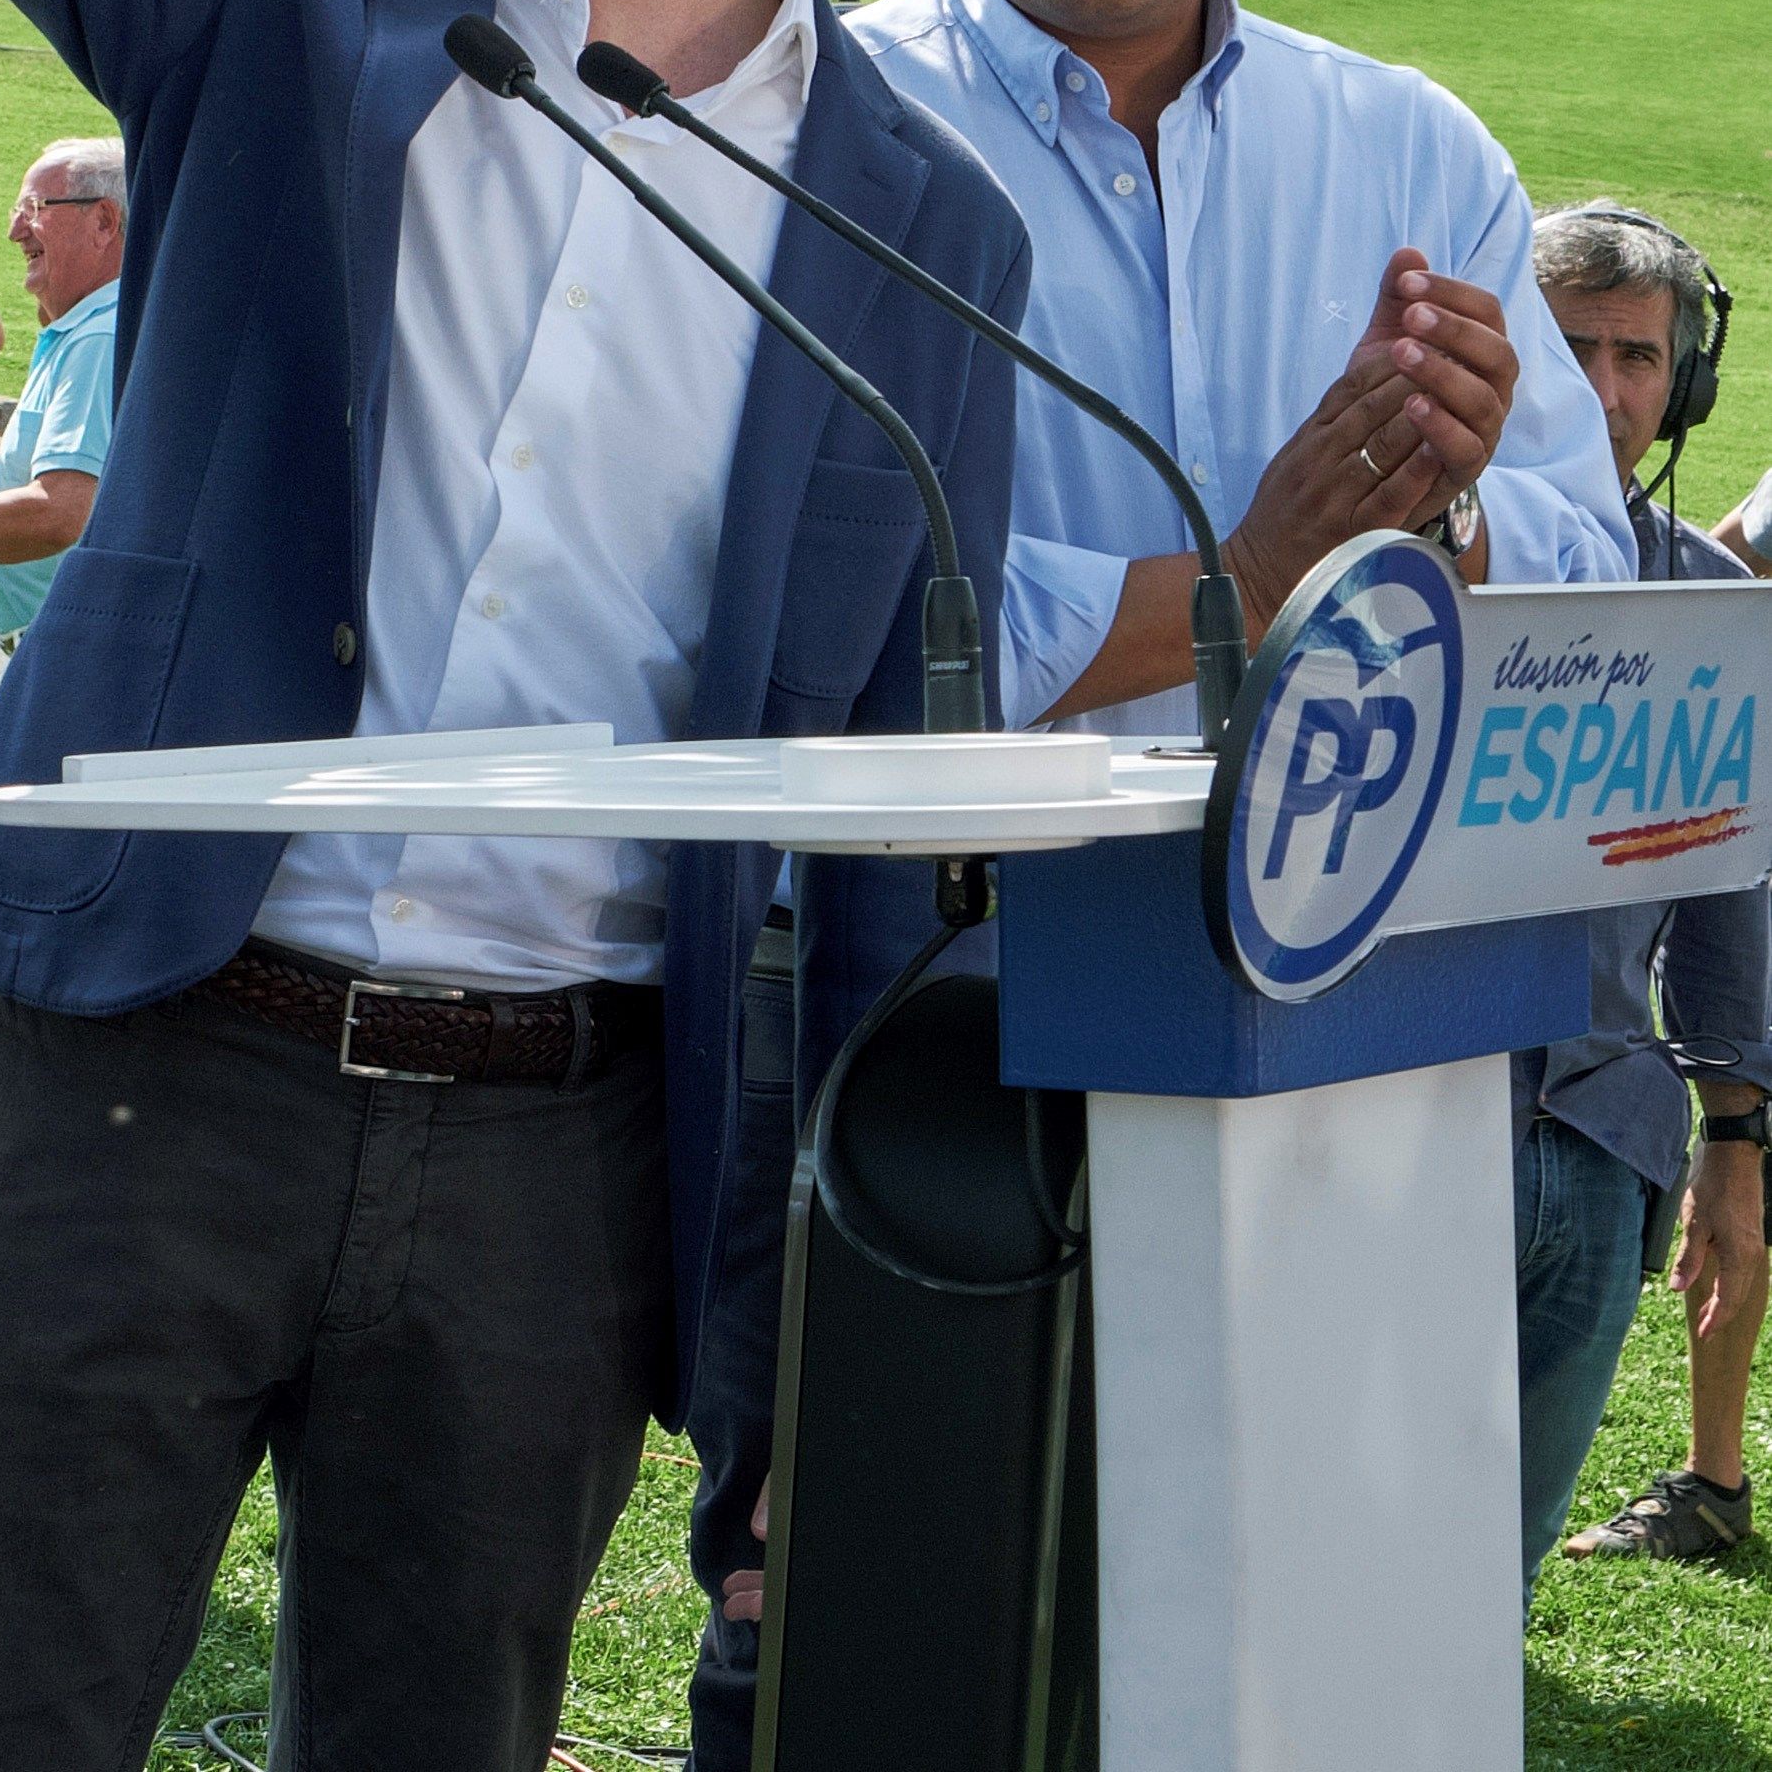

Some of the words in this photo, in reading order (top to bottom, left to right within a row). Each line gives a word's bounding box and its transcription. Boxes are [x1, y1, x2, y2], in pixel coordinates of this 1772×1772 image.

[1458, 664, 1756, 827] ESPAÑA
[1494, 633, 1604, 693] ilusión
[1597, 648, 1655, 707] por
[1262, 695, 1417, 880] PP
